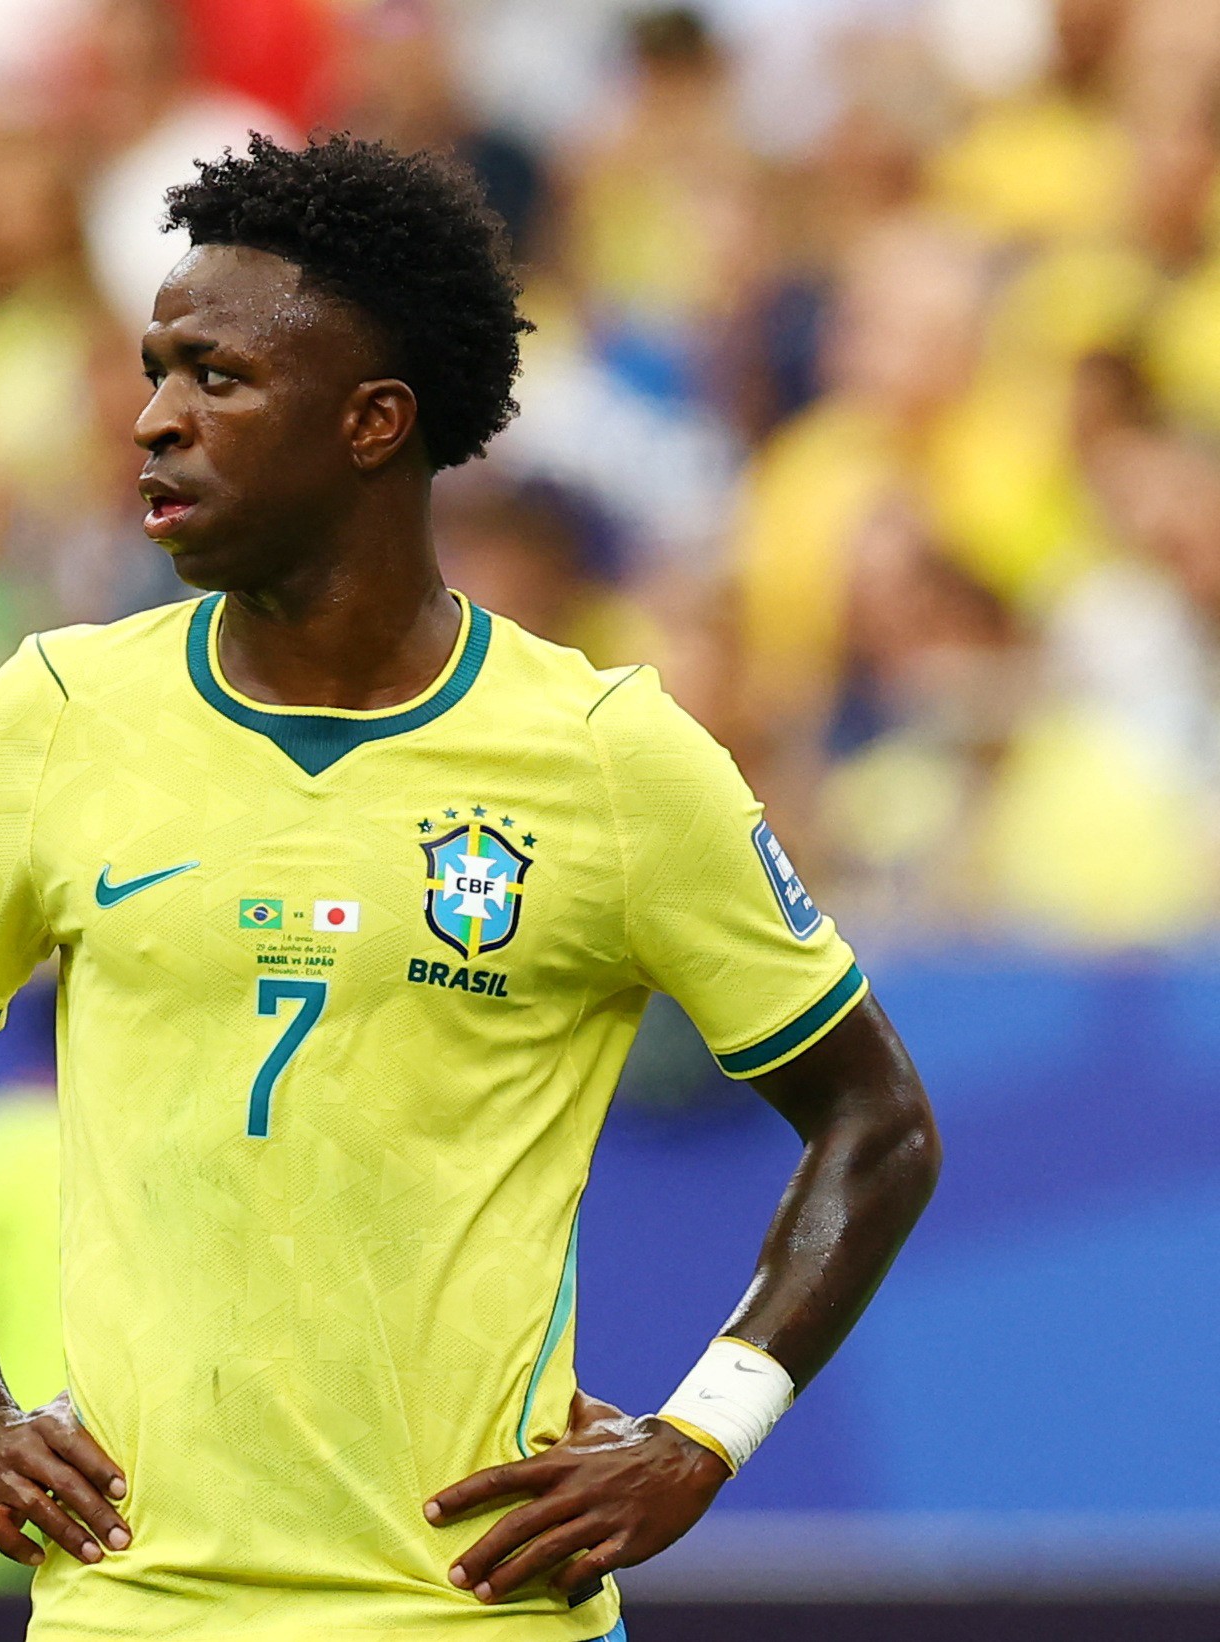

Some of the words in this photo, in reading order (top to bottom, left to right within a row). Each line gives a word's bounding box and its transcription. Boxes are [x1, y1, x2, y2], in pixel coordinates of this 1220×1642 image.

[456, 877, 495, 895] CBF
[256, 943, 266, 951] 29
[317, 946, 337, 954] 2026
[257, 955, 288, 964] BRASIL
[291, 957, 302, 965] vs
[305, 956, 334, 966] JAPÃO
[407, 957, 509, 998] BRASIL
[246, 977, 329, 1138] 7
